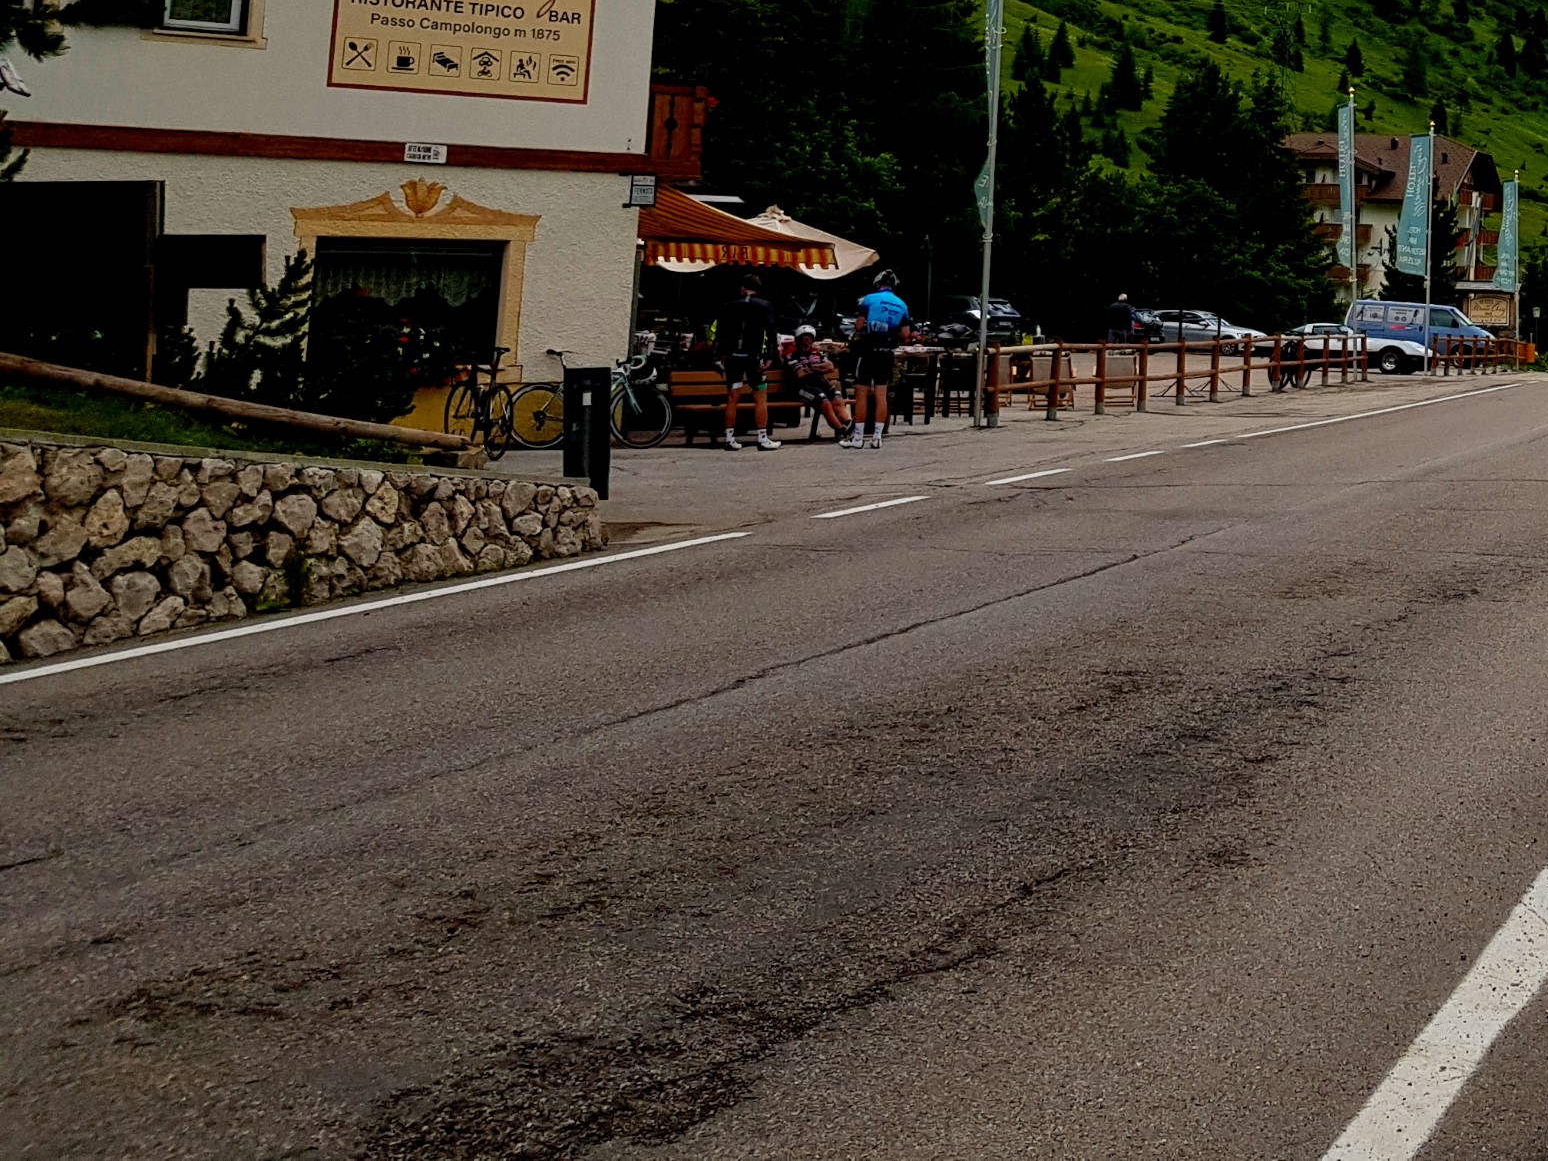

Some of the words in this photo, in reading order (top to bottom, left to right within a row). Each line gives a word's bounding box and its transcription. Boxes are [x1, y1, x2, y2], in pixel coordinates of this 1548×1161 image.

[370, 12, 416, 29] Passo
[419, 17, 511, 39] Campolongo
[513, 28, 527, 39] m
[530, 27, 562, 42] 1875
[469, 2, 526, 20] TIPICO
[547, 9, 582, 26] BAR
